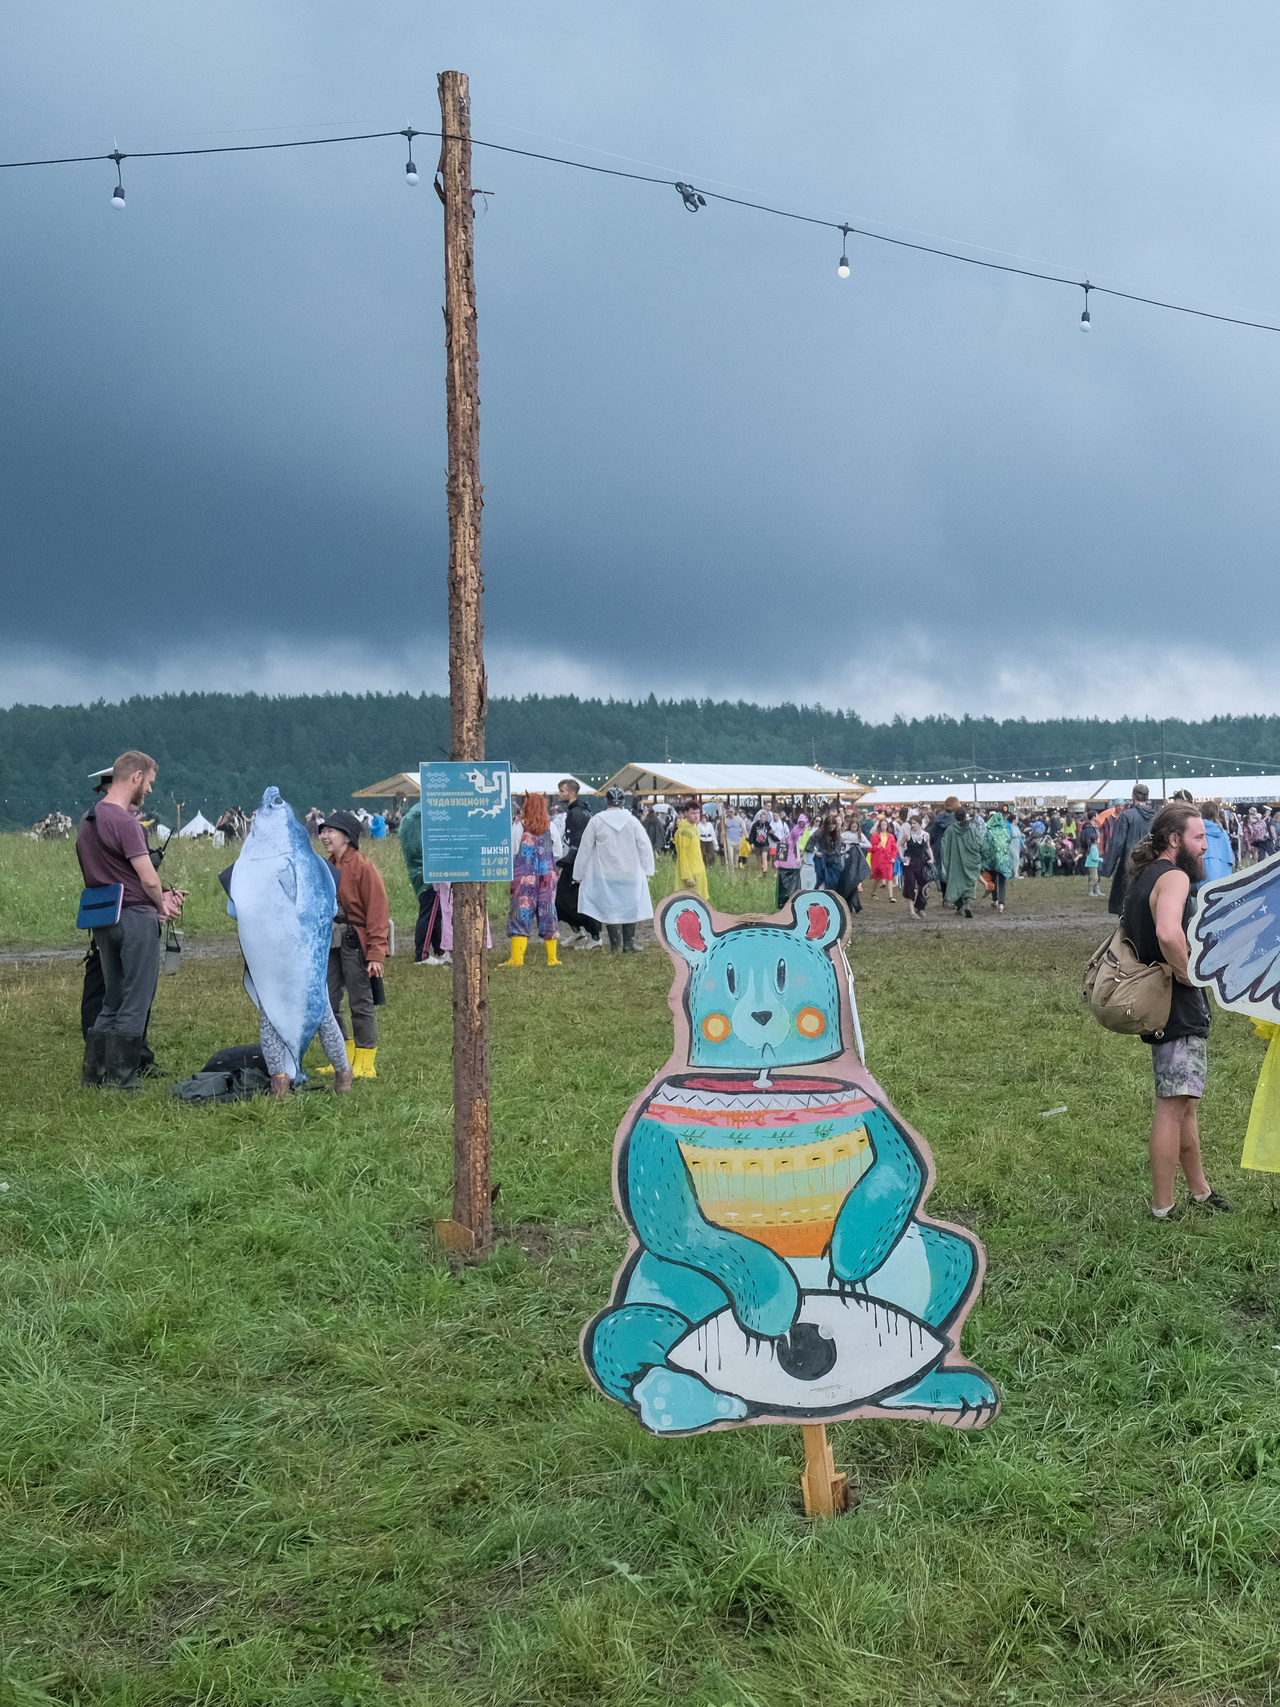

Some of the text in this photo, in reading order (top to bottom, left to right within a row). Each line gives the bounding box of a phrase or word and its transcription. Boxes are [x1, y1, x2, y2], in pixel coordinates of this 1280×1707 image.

[481, 846, 510, 855] ВЫКУП
[481, 857, 509, 866] 21/07
[481, 868, 509, 877] 18:00
